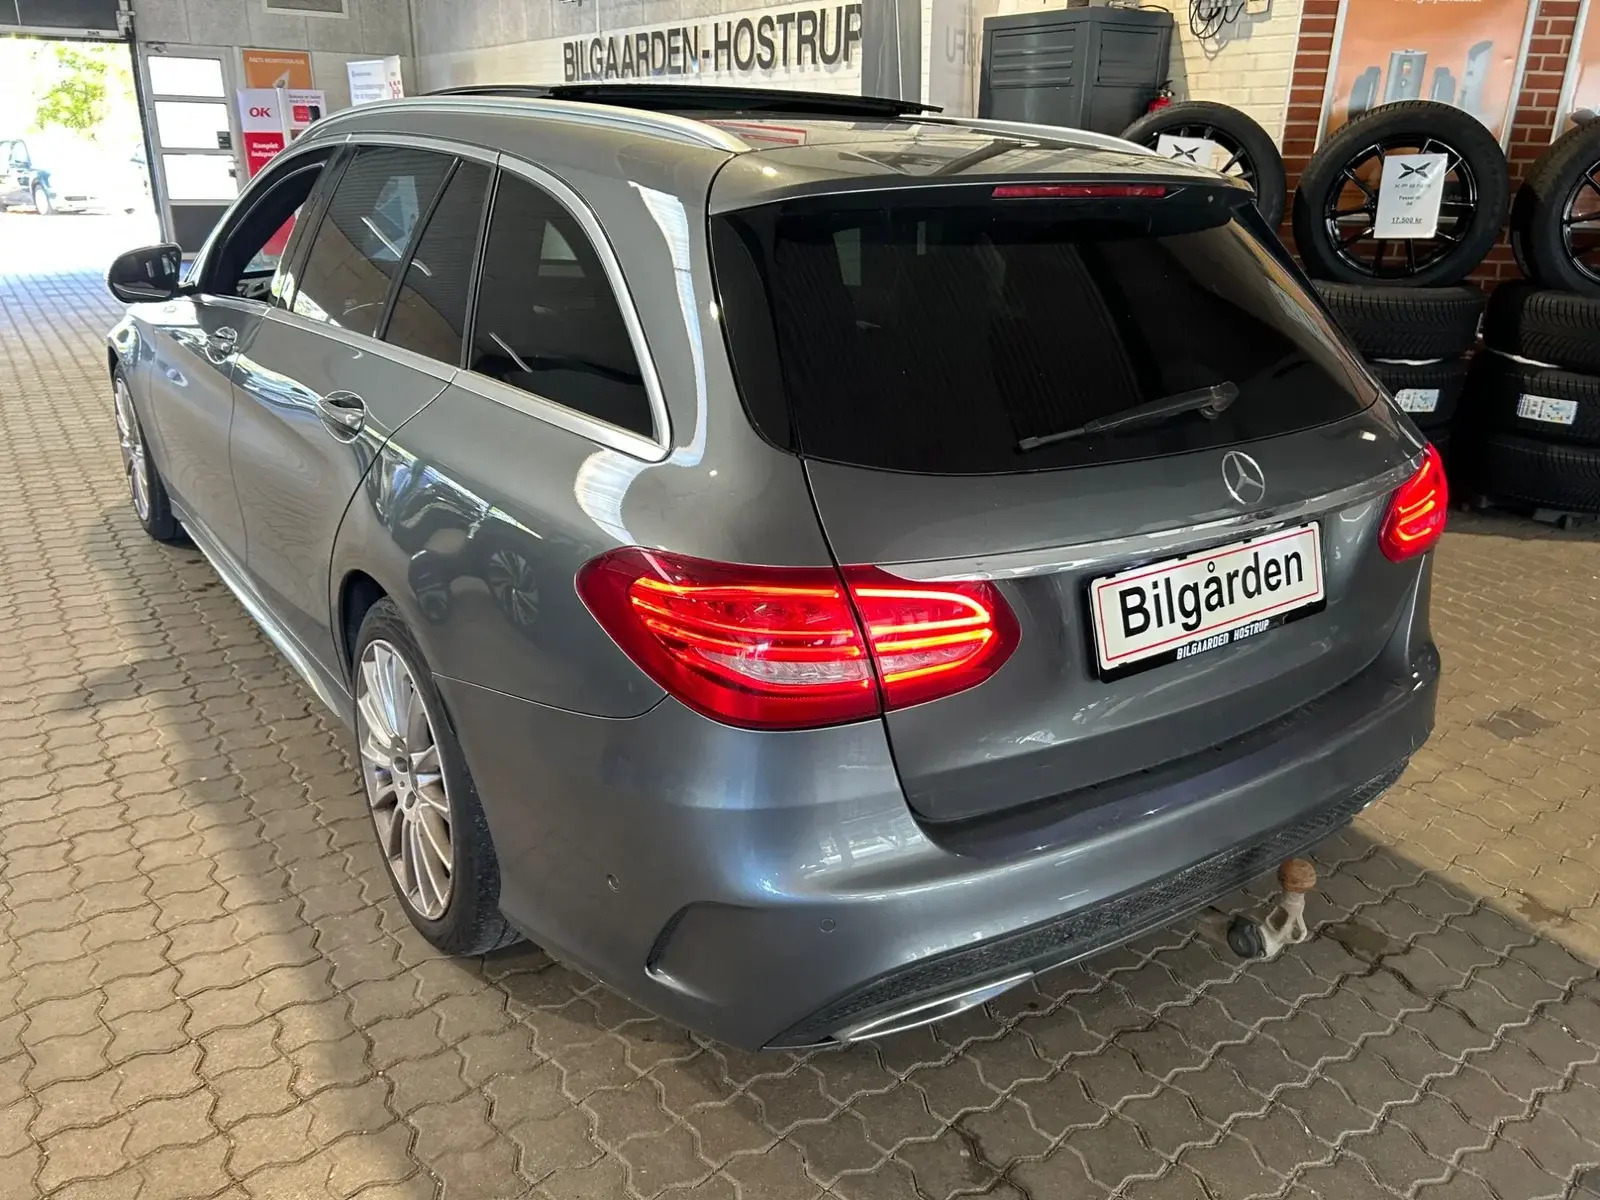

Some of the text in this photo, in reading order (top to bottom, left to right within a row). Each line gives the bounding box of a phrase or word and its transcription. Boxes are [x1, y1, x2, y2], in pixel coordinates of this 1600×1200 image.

[249, 107, 271, 117] OK
[252, 142, 279, 150] Komplet
[1118, 550, 1303, 638] Bilgården
[1176, 619, 1270, 660] BILGAARDEN HOSTRUP
